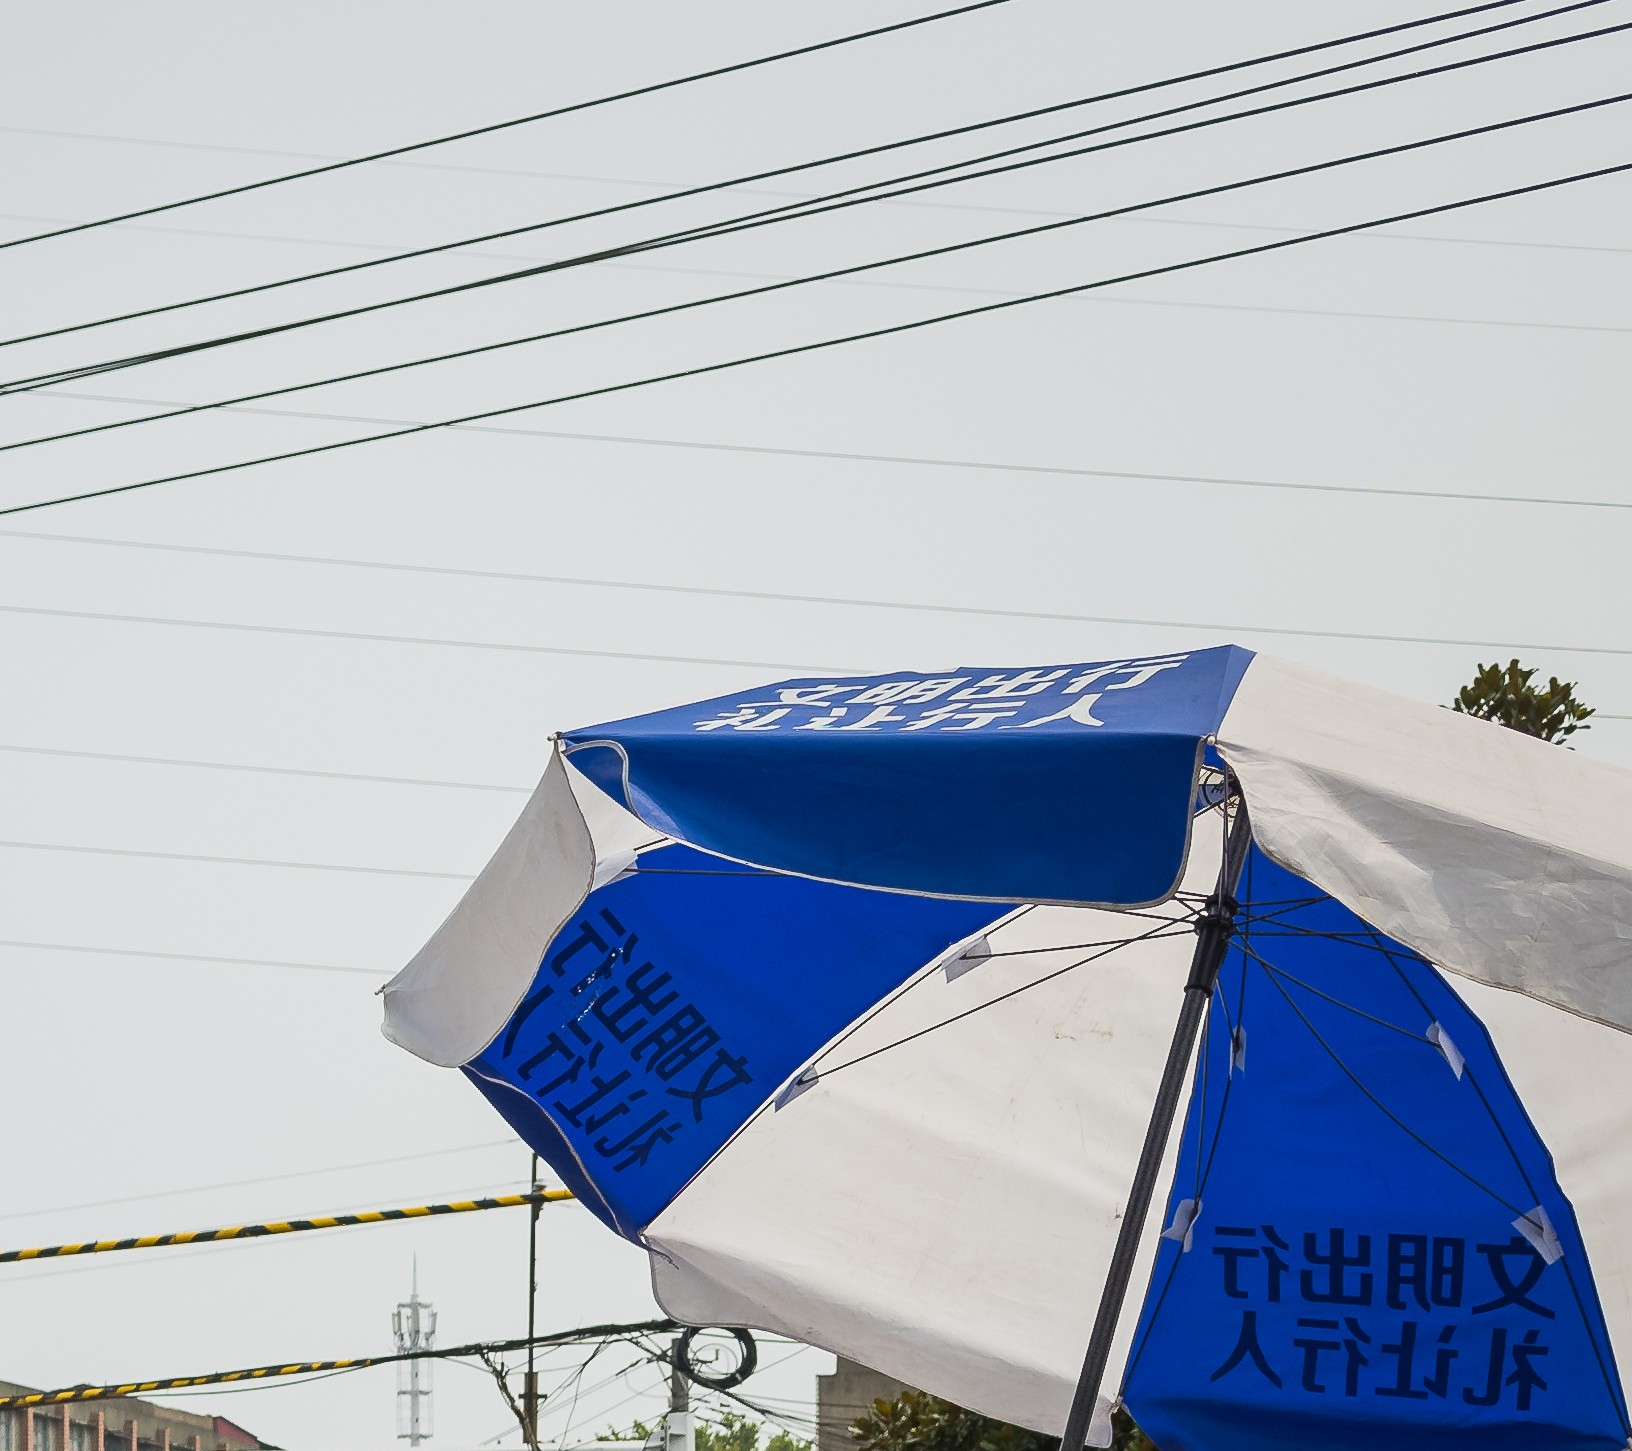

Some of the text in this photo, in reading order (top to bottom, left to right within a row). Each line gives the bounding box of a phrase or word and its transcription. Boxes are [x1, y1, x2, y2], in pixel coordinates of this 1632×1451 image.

[737, 654, 1189, 707] 文明出行
[694, 692, 1104, 731] 礼让行人
